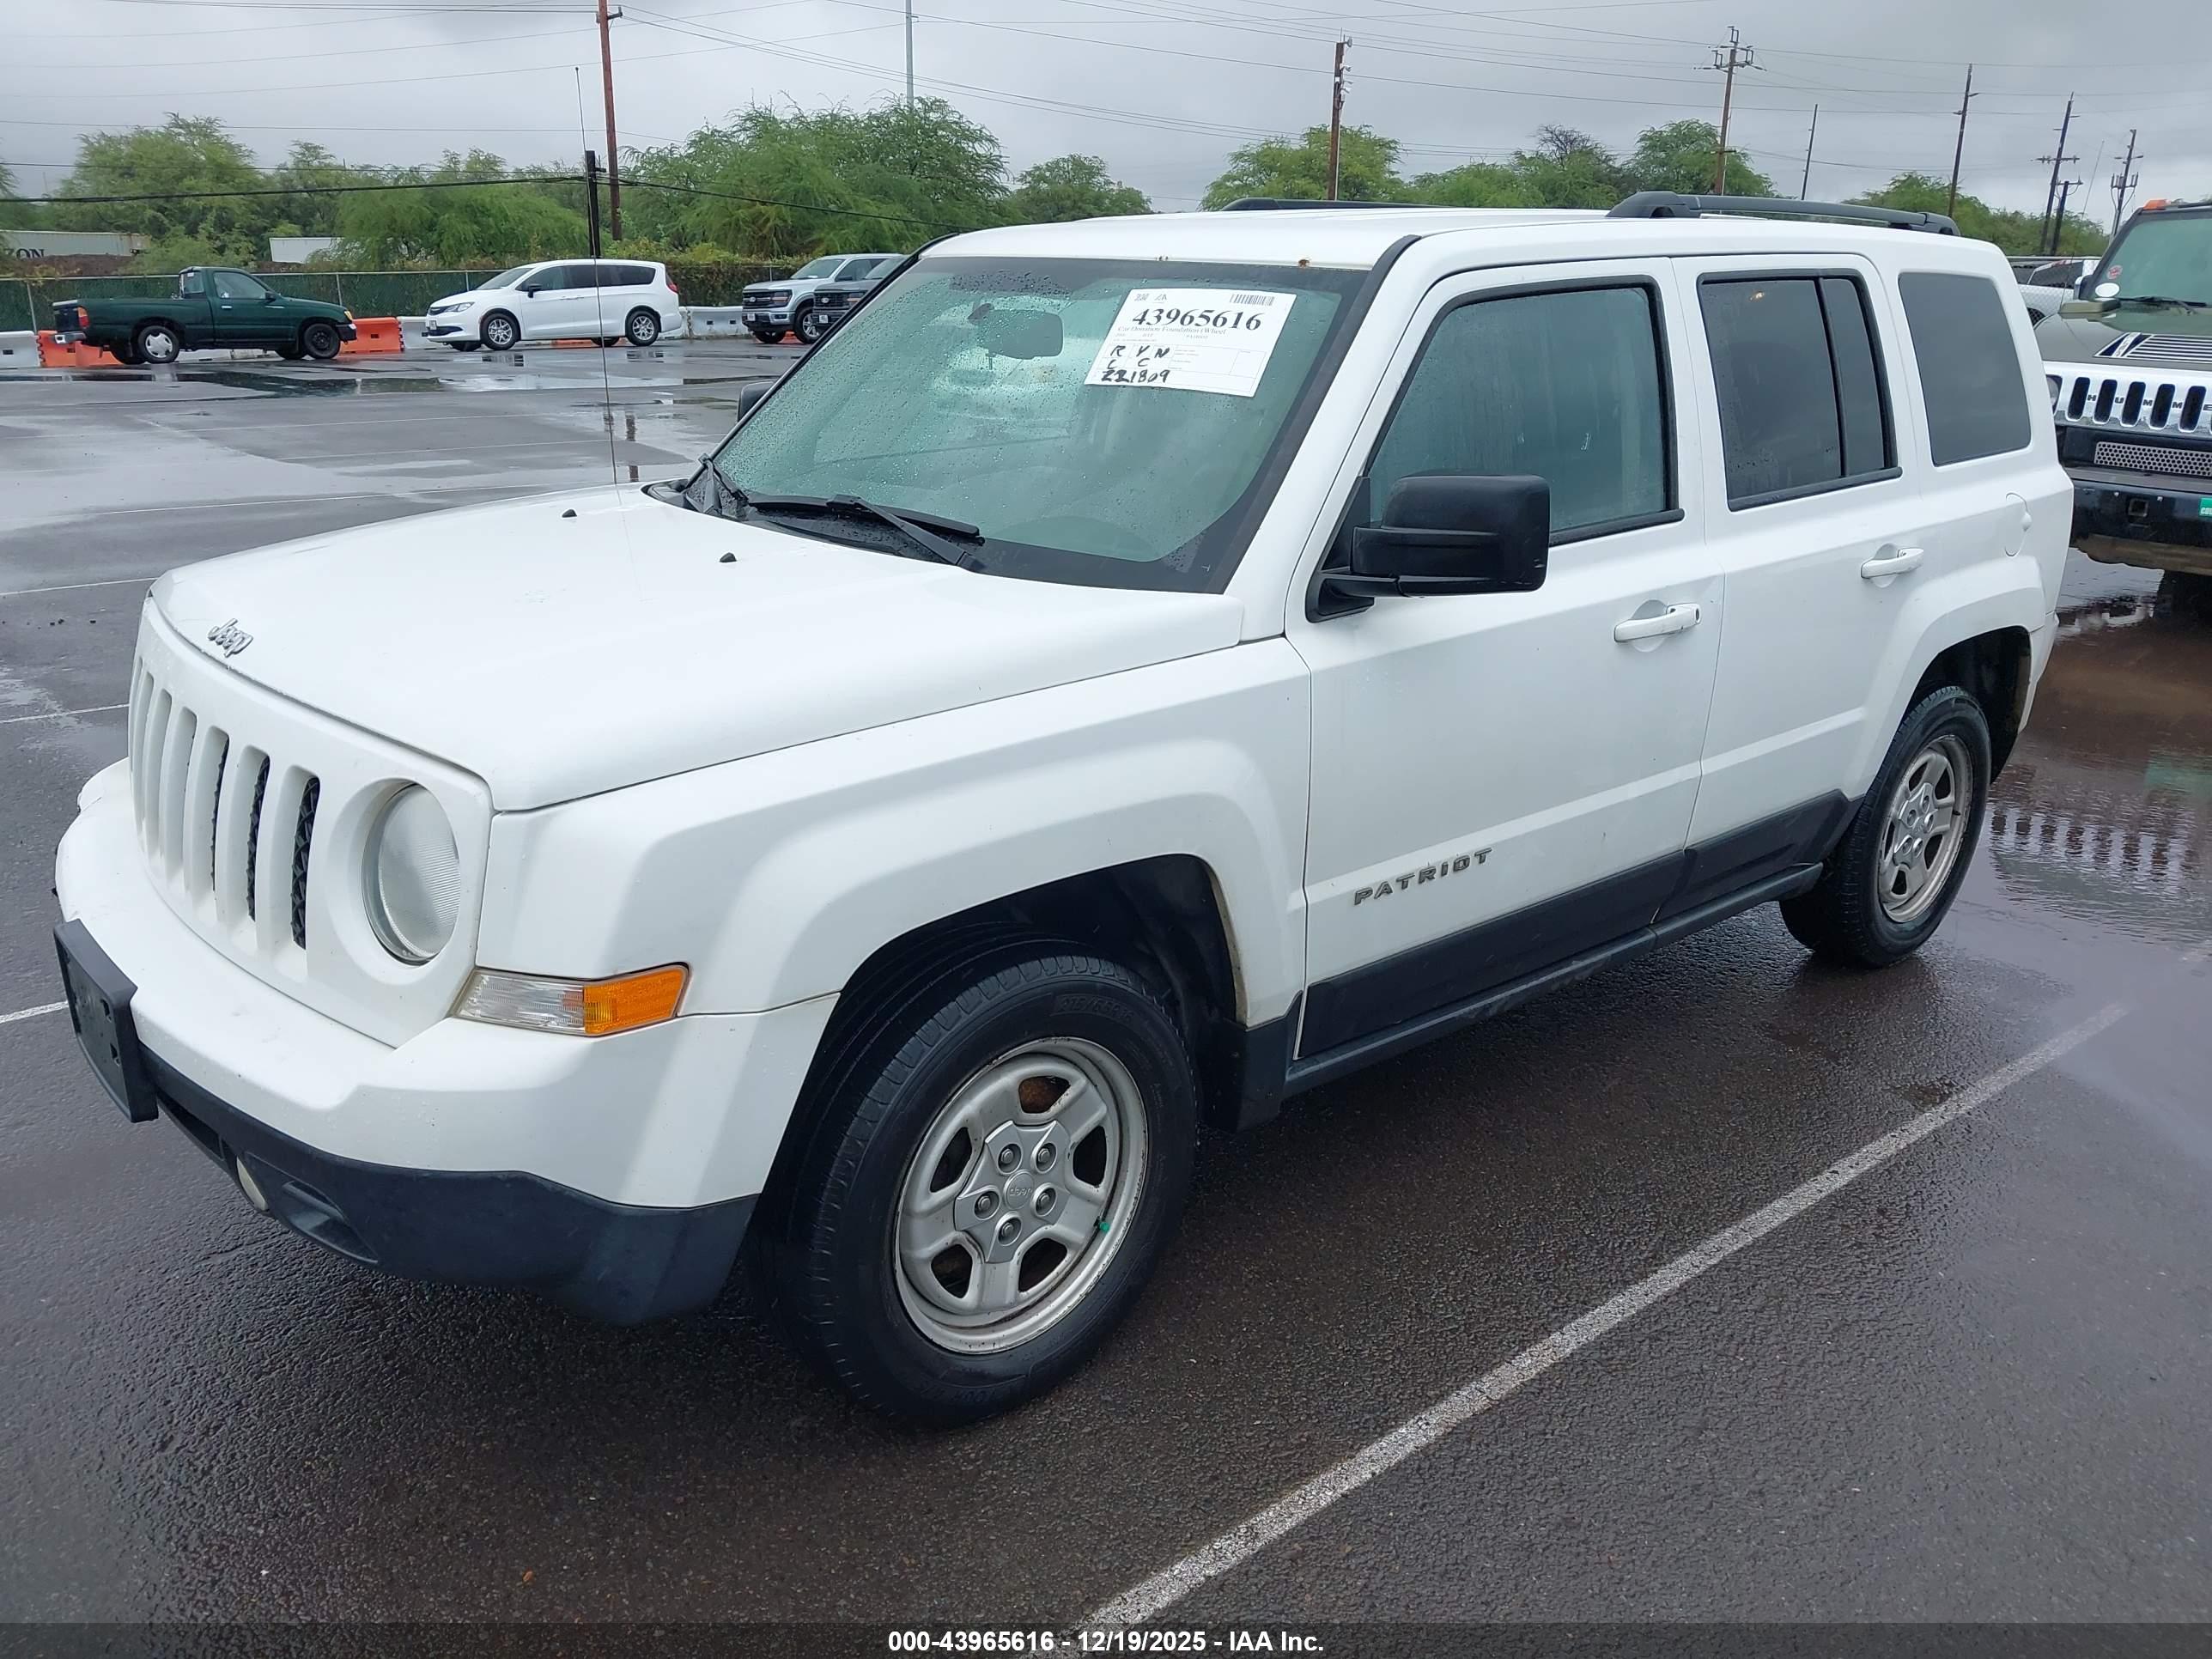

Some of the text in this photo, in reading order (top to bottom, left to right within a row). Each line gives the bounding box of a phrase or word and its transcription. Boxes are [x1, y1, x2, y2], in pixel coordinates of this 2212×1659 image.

[1132, 307, 1266, 331] 43965616
[1110, 345, 1127, 357] R
[207, 617, 254, 659] Jeep
[1353, 847, 1493, 906] PATRIOT
